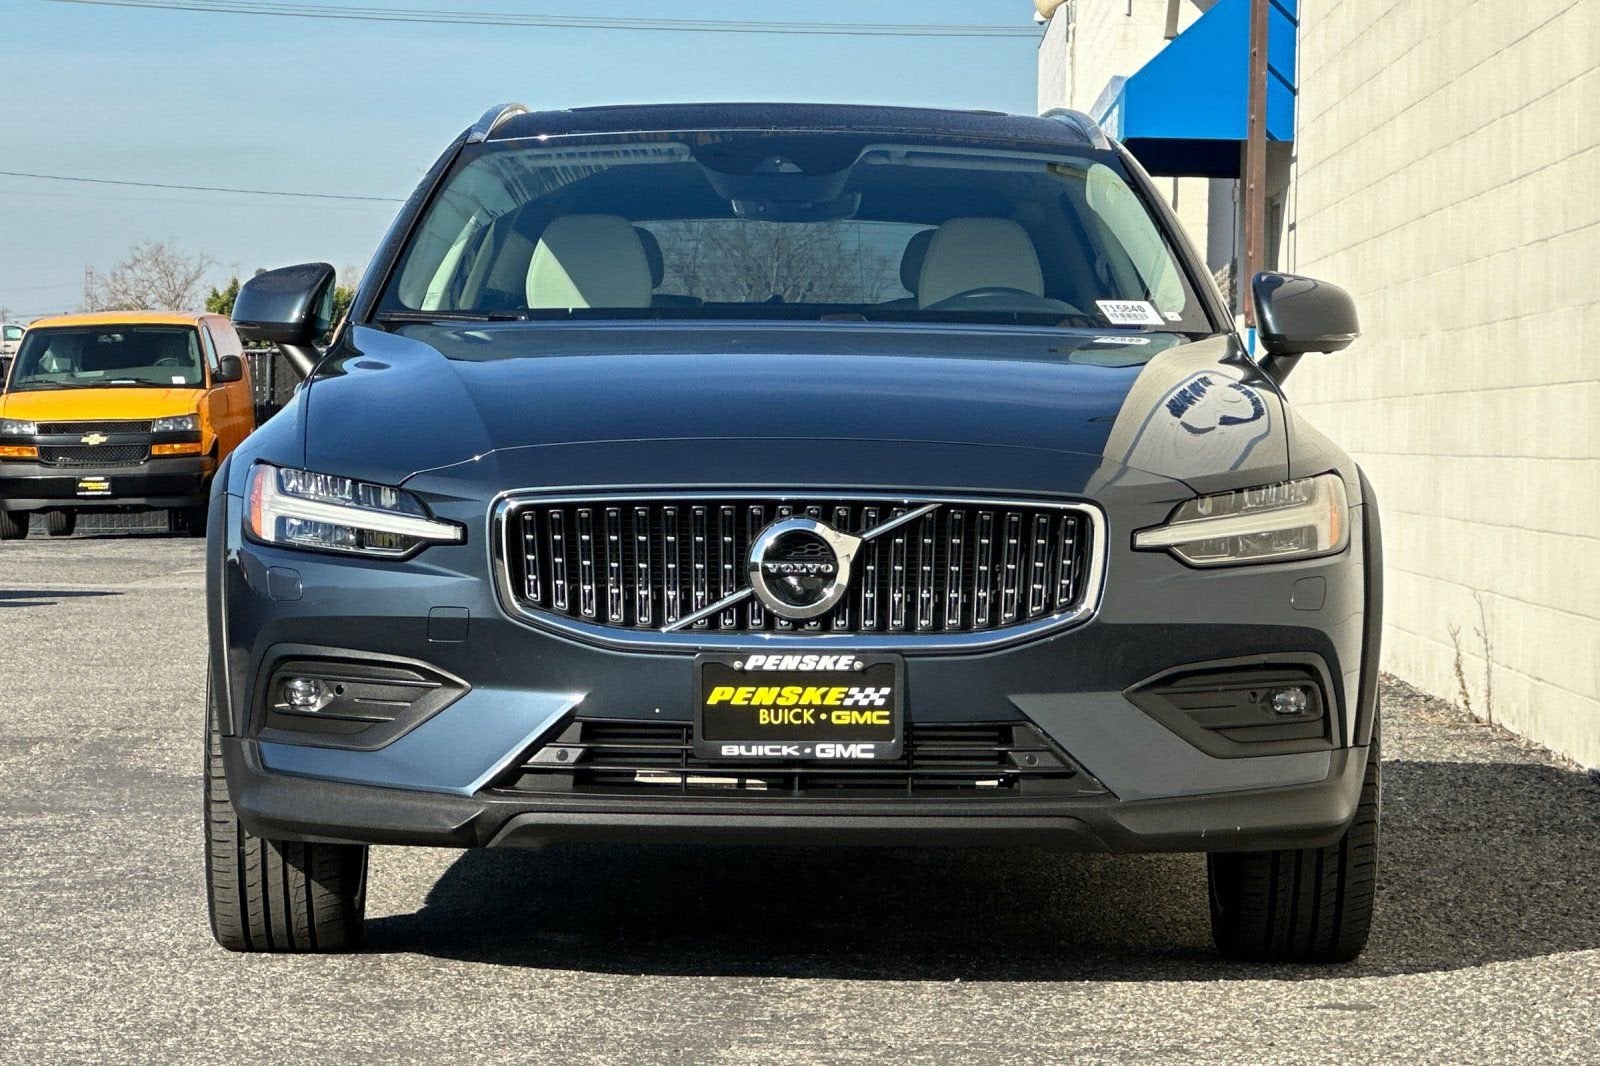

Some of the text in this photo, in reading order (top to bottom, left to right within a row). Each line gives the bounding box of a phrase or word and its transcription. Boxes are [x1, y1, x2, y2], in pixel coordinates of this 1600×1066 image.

[1101, 304, 1146, 313] T15840
[764, 563, 834, 573] VOLVO
[744, 655, 855, 671] PENSKE
[706, 686, 848, 706] PENSKE
[759, 708, 890, 725] BUICK GMC
[721, 744, 875, 759] BUICK GMC
